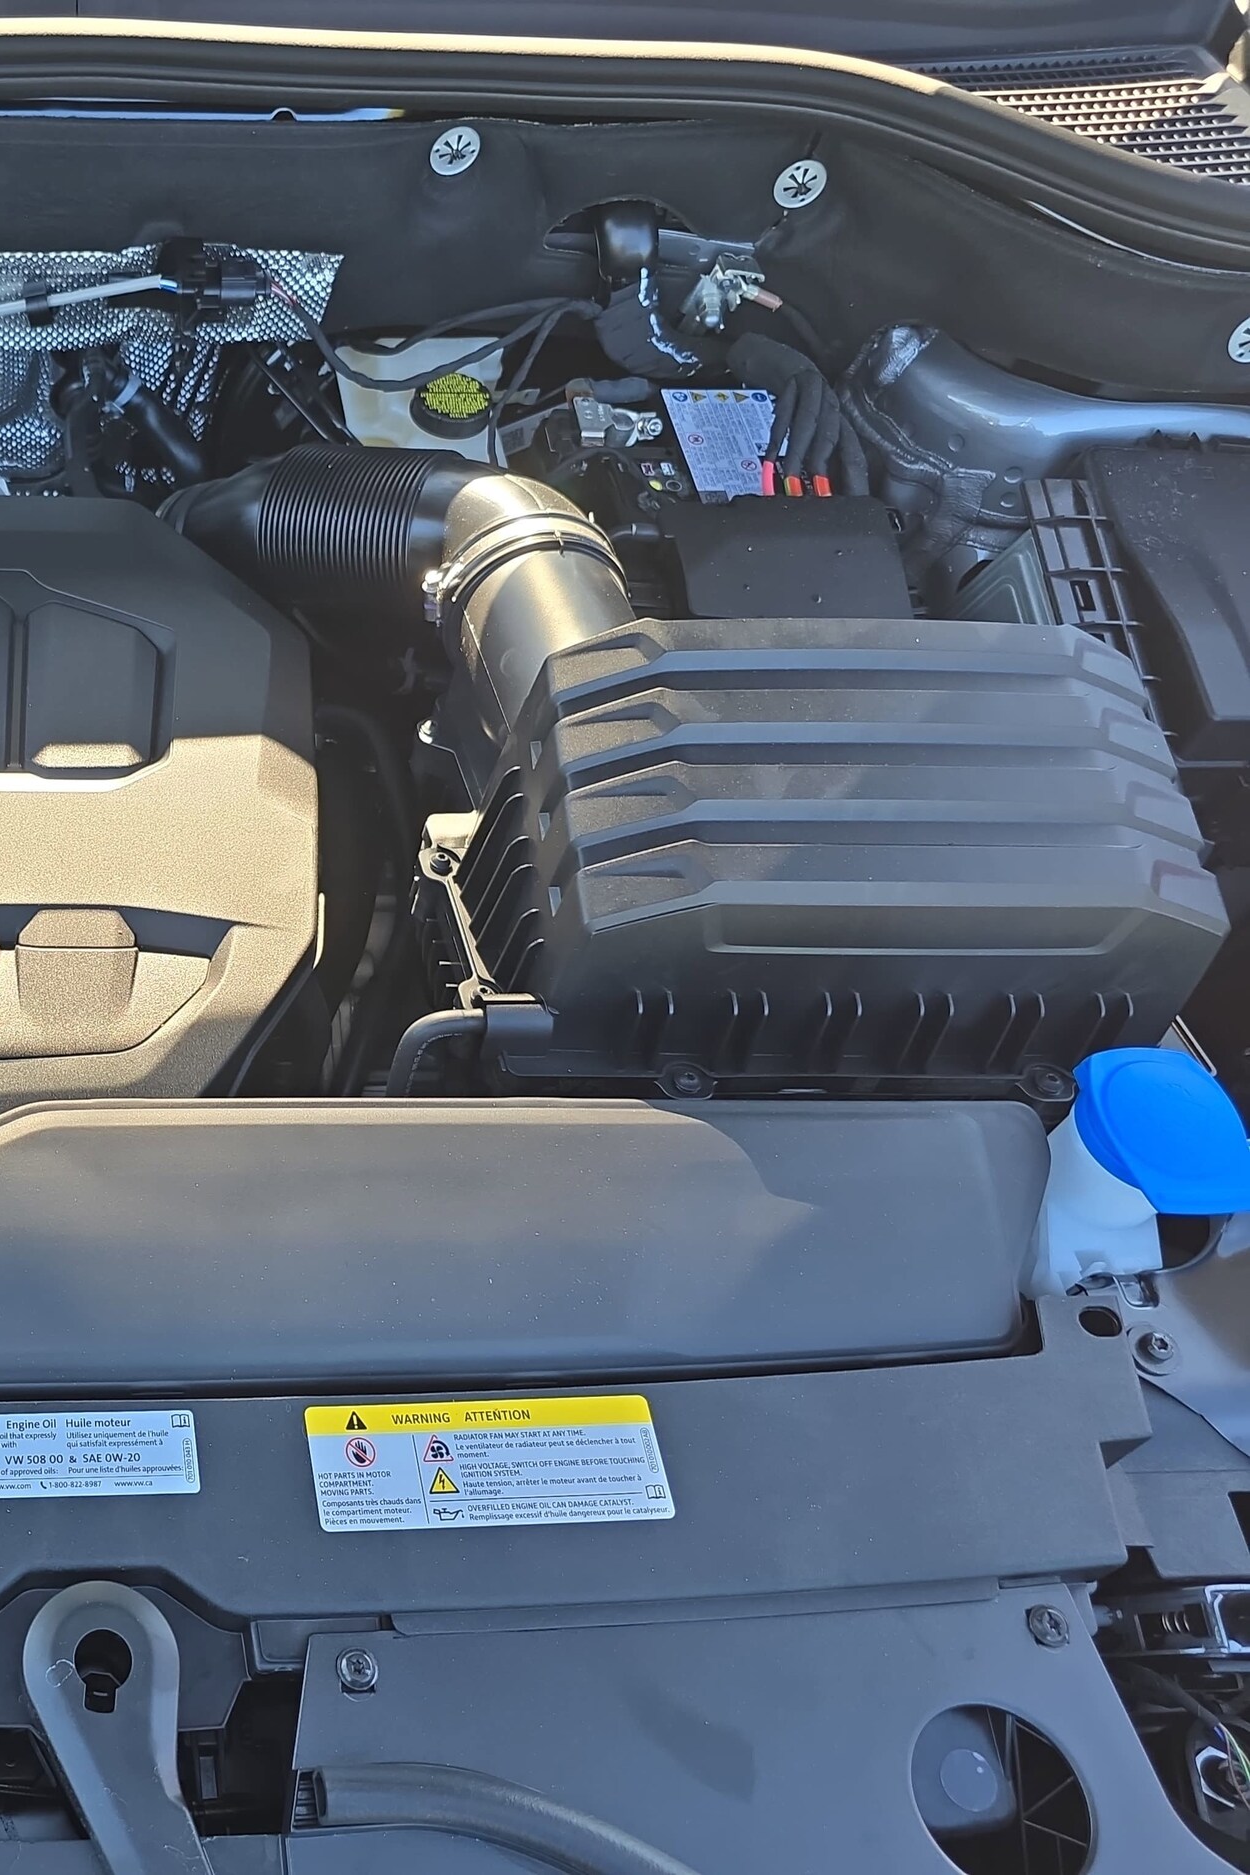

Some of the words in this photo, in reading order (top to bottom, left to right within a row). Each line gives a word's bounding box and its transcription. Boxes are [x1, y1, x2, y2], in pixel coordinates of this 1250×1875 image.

[391, 1413, 450, 1425] WARNING
[464, 1409, 531, 1422] ATTENTION
[6, 1420, 40, 1432] Engine
[42, 1419, 57, 1428] Oil
[66, 1418, 92, 1428] Huile
[94, 1419, 131, 1427] moteur
[0, 1432, 8, 1440] oil
[9, 1432, 24, 1440] that
[25, 1432, 57, 1440] expressly
[94, 1431, 136, 1440] uniquement
[138, 1430, 146, 1438] de
[66, 1441, 78, 1449] qui
[109, 1439, 157, 1448] expressément
[466, 1442, 503, 1450] ventilateur
[548, 1440, 565, 1448] peut
[575, 1438, 613, 1446] déclencher
[5, 1455, 24, 1465] VW
[27, 1454, 46, 1464] 508
[49, 1454, 64, 1464] 00
[69, 1456, 77, 1464] &
[82, 1453, 102, 1463] SAE
[105, 1452, 141, 1462] 0W-20
[478, 1462, 510, 1470] VOLTAGE,
[554, 1459, 580, 1467] ENGINE
[581, 1458, 608, 1466] BEFORE
[609, 1456, 646, 1465] TOUCHING
[1, 1468, 8, 1476] of
[9, 1467, 42, 1477] approved
[115, 1465, 141, 1473] d'huiles
[319, 1480, 374, 1488] COMPARTMENT.
[486, 1480, 514, 1488] tension,
[516, 1478, 540, 1486] arrêter
[350, 1488, 374, 1496] PARTS.
[322, 1500, 364, 1508] Composants
[467, 1504, 510, 1512] OVERFILLED
[511, 1502, 538, 1510] ENGINE
[568, 1500, 598, 1508] DAMAGE
[599, 1498, 634, 1507] CATALYST.
[332, 1508, 382, 1517] compartiment
[469, 1513, 514, 1521] Remplissage
[515, 1511, 542, 1519] excessif
[543, 1510, 568, 1518] d'huile
[568, 1510, 605, 1518] dangereux
[632, 1507, 670, 1515] catalyseur.
[325, 1518, 347, 1526] Pièces
